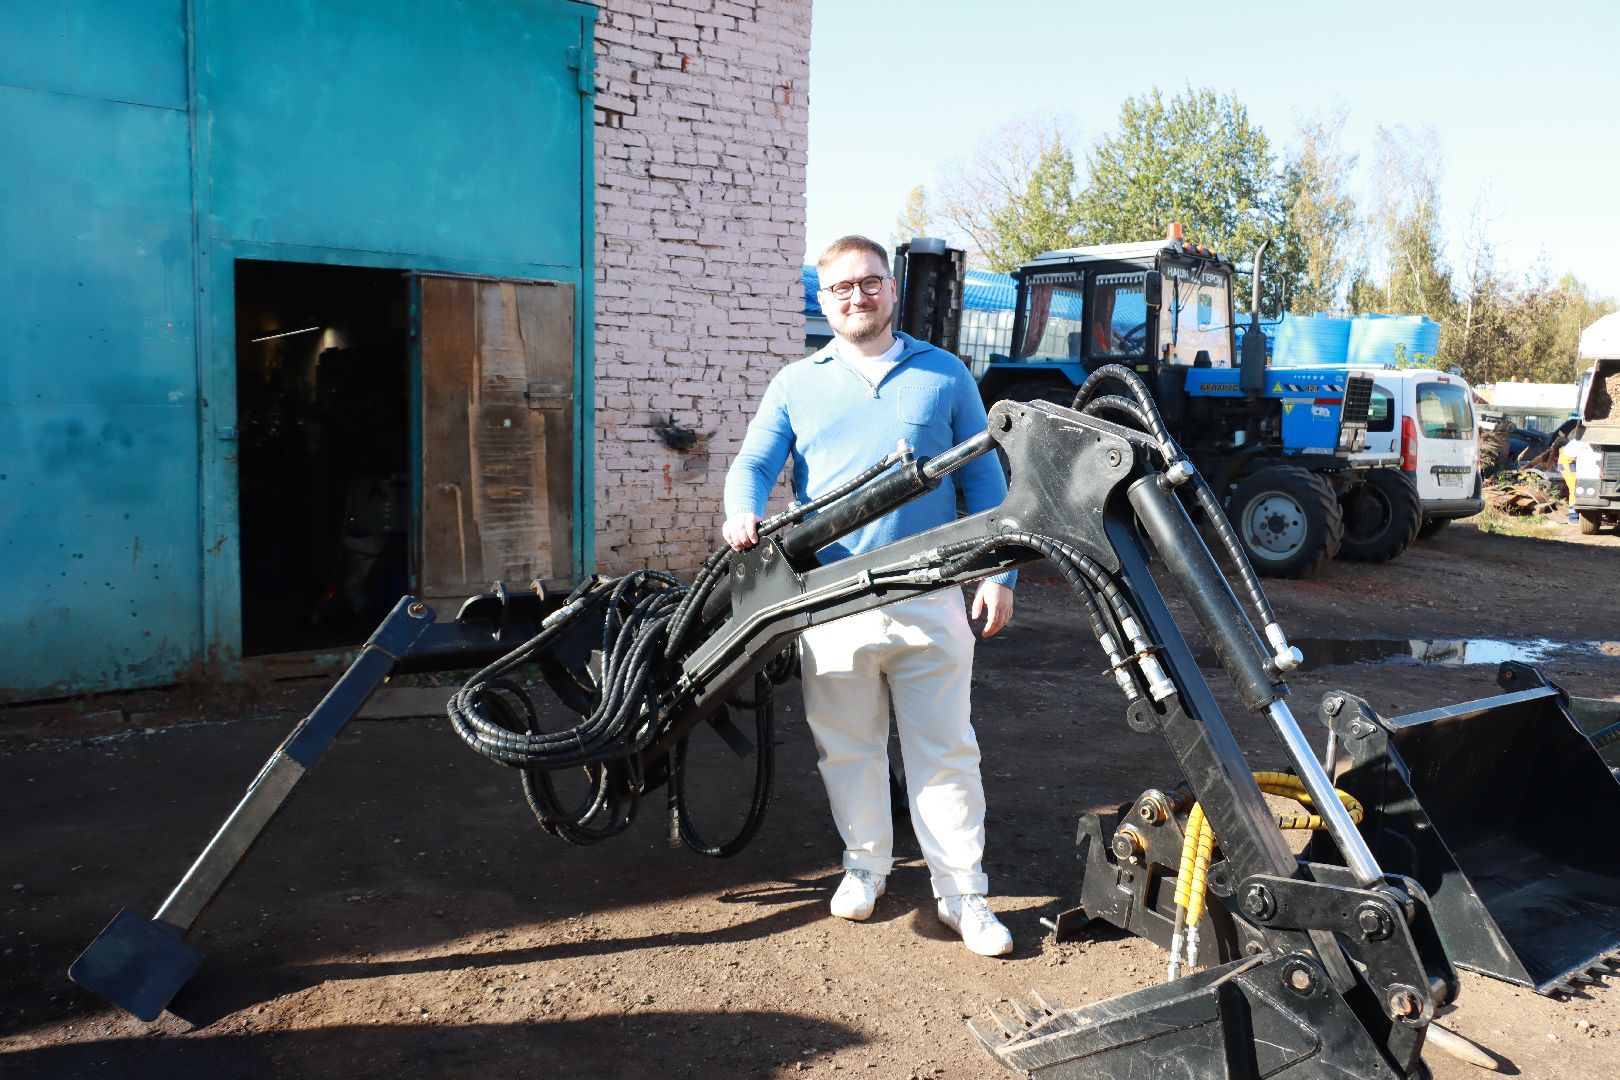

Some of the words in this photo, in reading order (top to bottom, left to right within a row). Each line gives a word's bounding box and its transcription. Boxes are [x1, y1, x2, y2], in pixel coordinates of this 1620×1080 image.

[1167, 266, 1189, 279] НАШИ
[1202, 272, 1223, 285] ГЕРОИ
[1200, 383, 1240, 392] БЕЛАРУС
